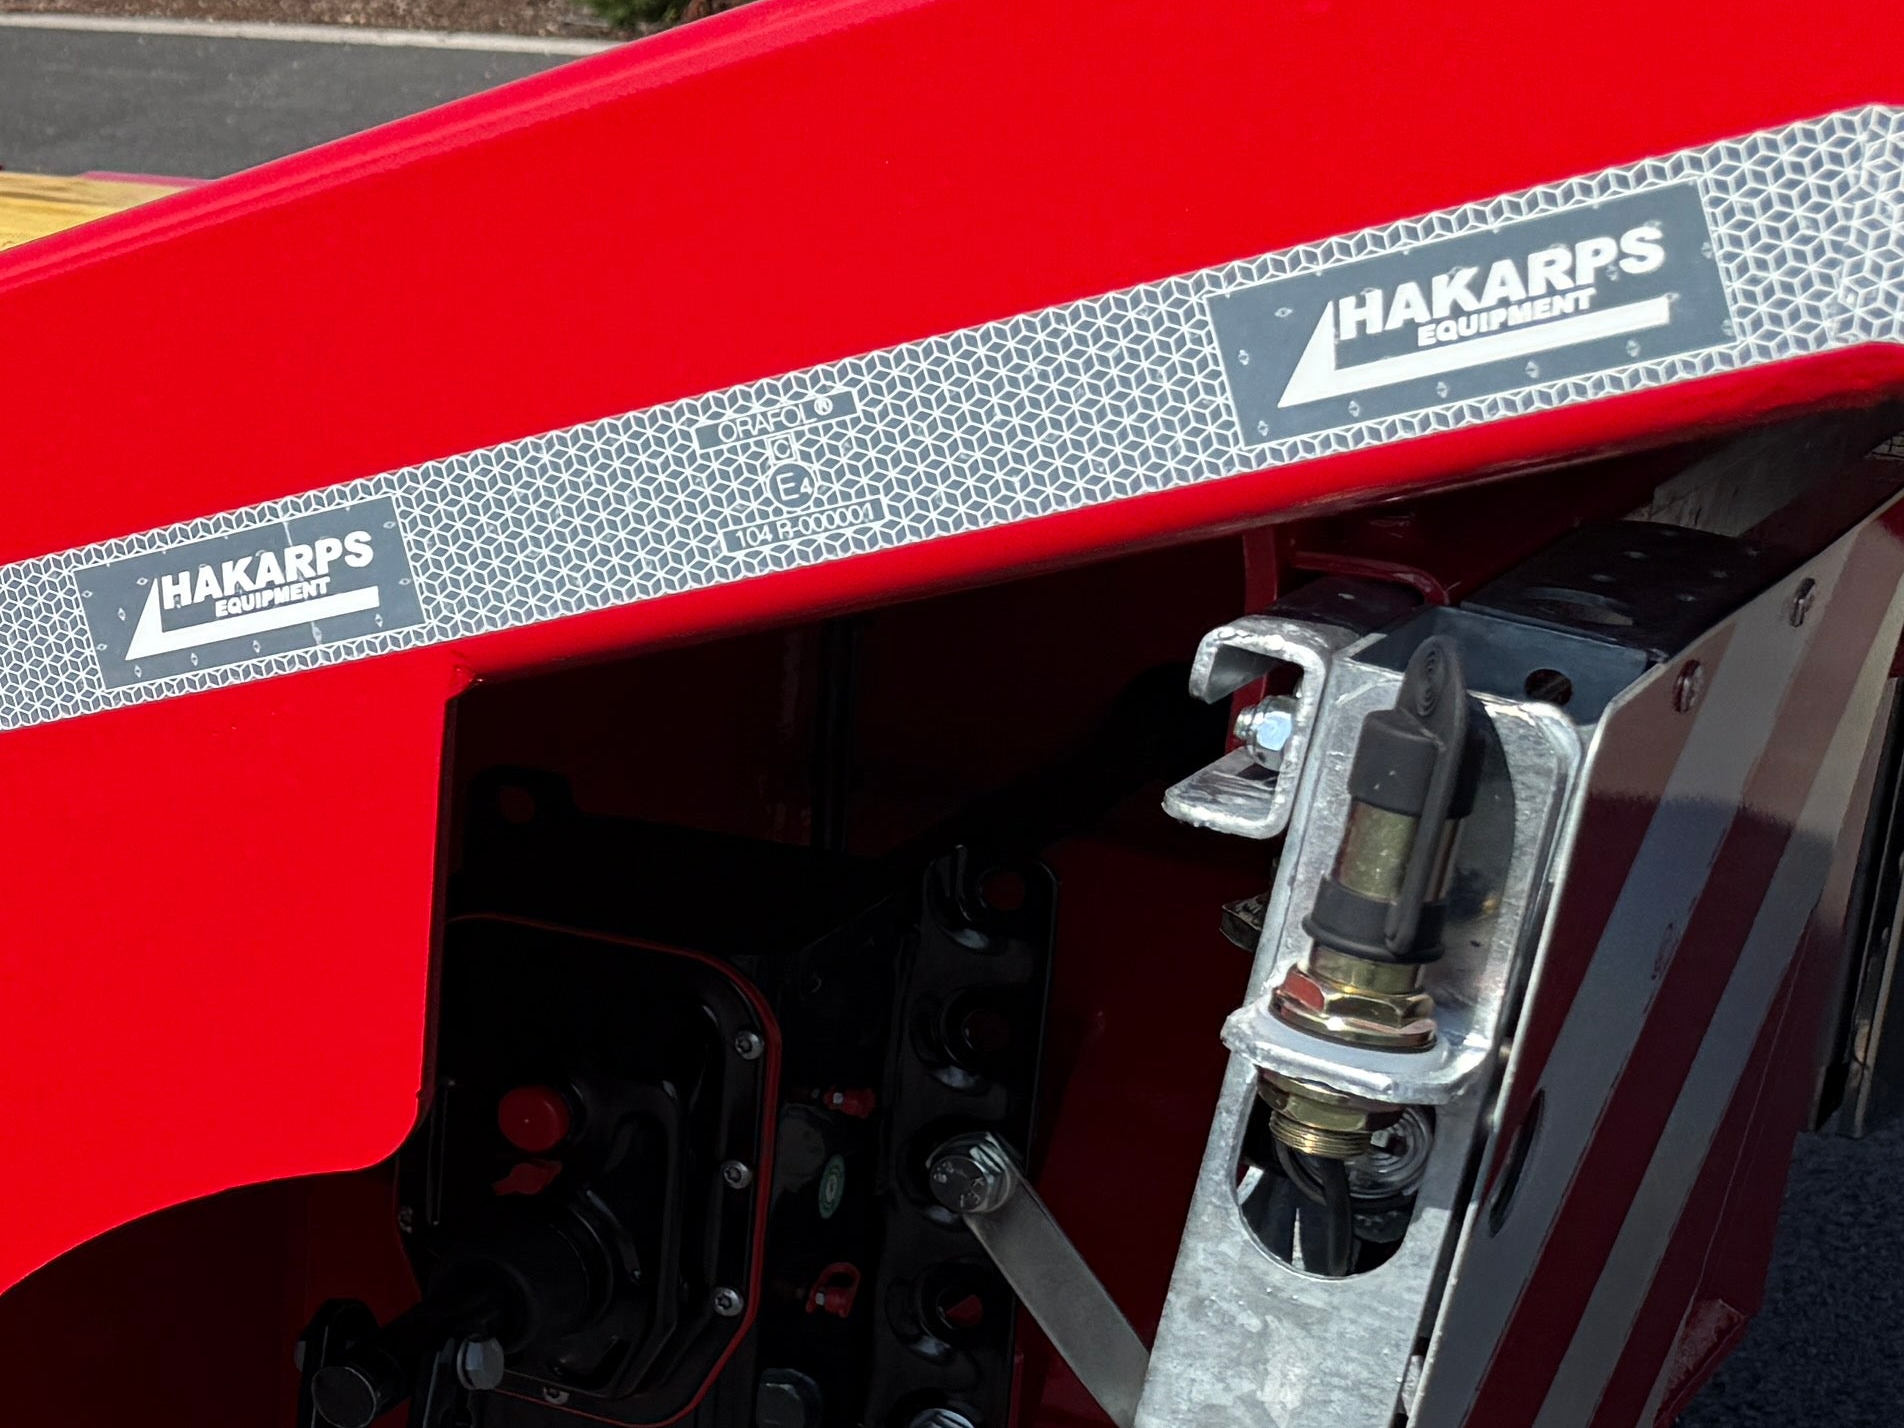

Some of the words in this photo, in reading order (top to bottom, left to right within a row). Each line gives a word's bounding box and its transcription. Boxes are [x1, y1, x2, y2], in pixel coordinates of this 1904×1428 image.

[1339, 225, 1666, 341] HAKARPS
[1417, 287, 1596, 347] EQUIPMENT
[735, 524, 773, 549] 104
[161, 530, 374, 611] HAKARPS
[214, 576, 332, 620] EQUIPMENT
